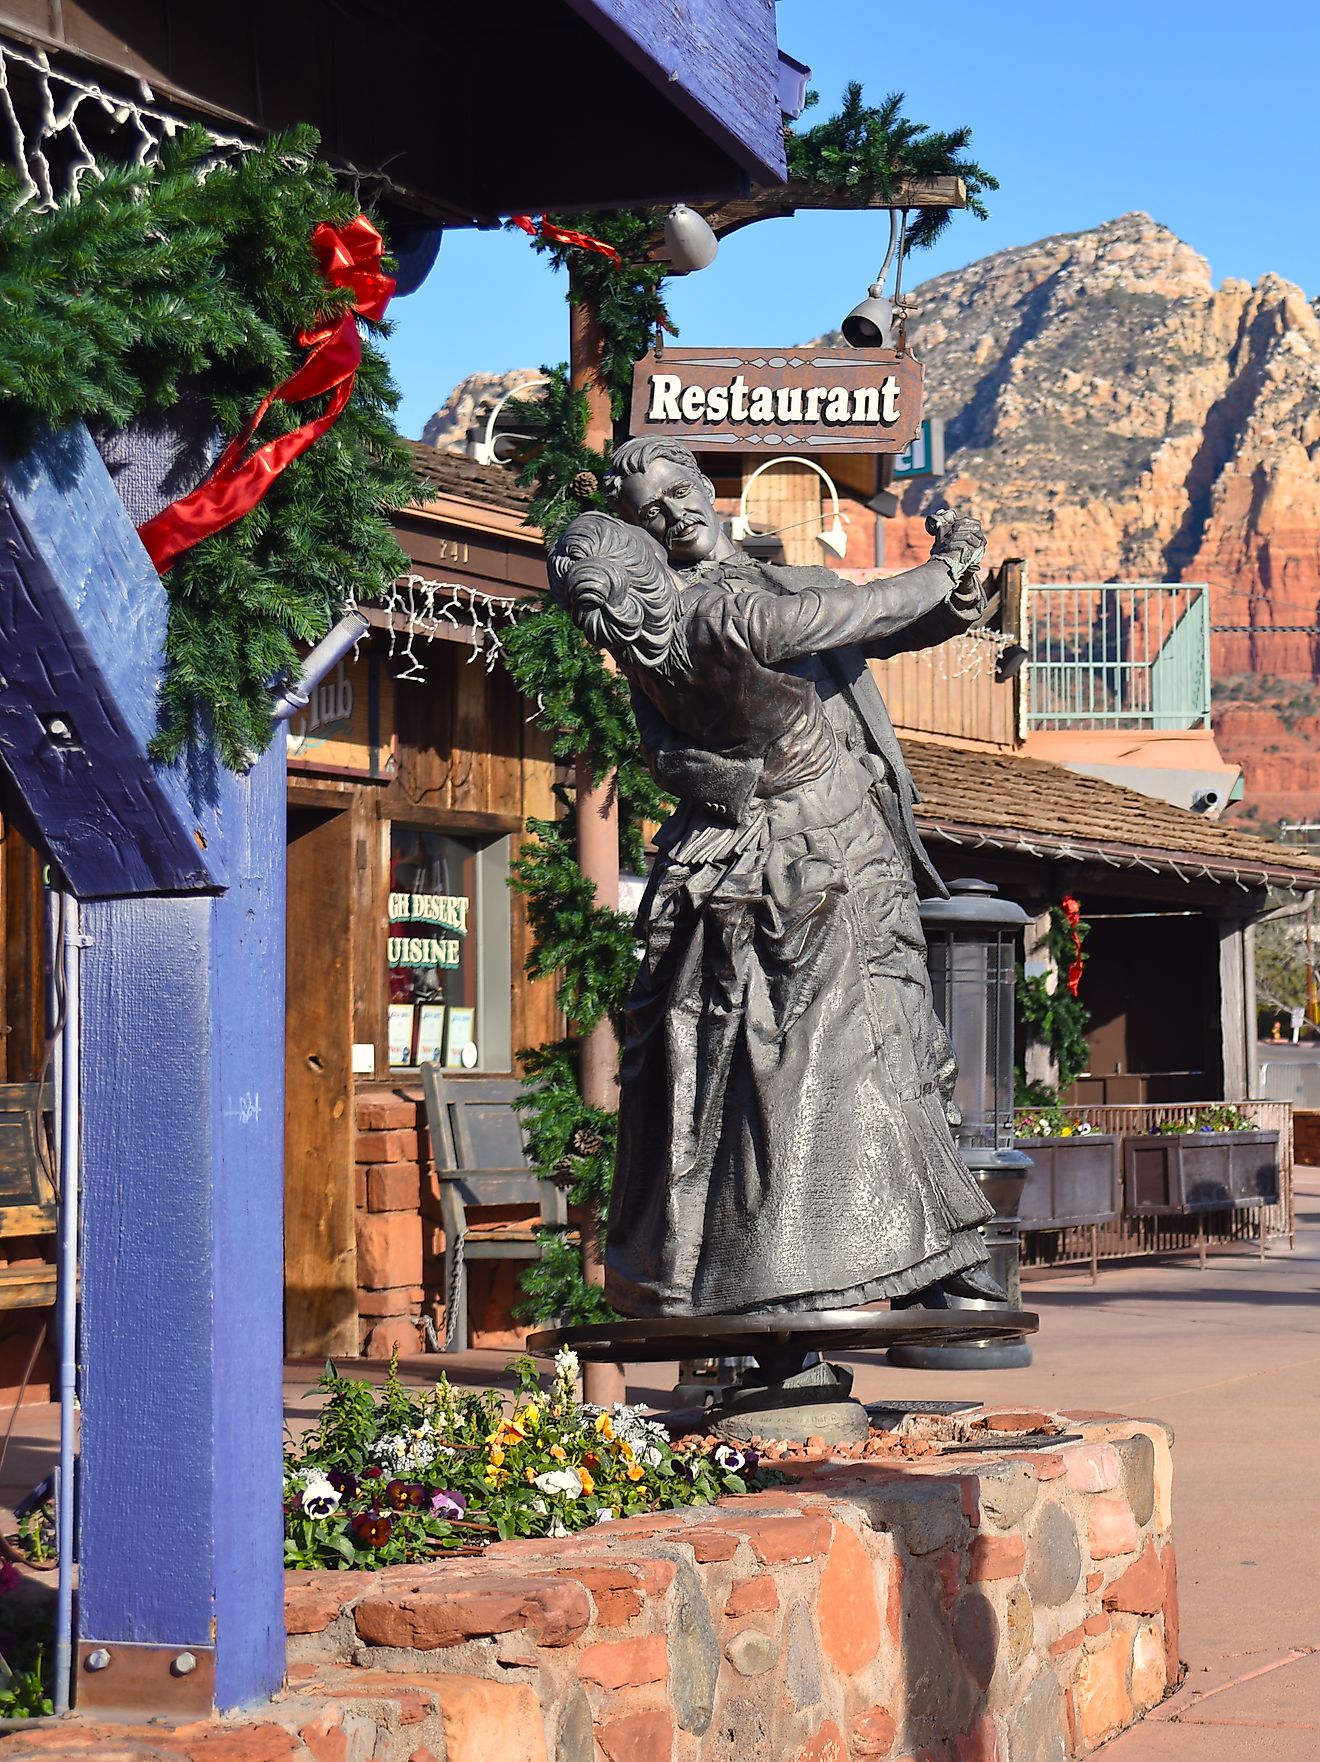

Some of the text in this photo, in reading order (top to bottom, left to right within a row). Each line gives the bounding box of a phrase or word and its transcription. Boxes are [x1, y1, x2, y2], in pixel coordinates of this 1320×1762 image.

[647, 373, 901, 424] Restaurant
[412, 893, 469, 934] DESERT
[388, 937, 460, 965] UISINE
